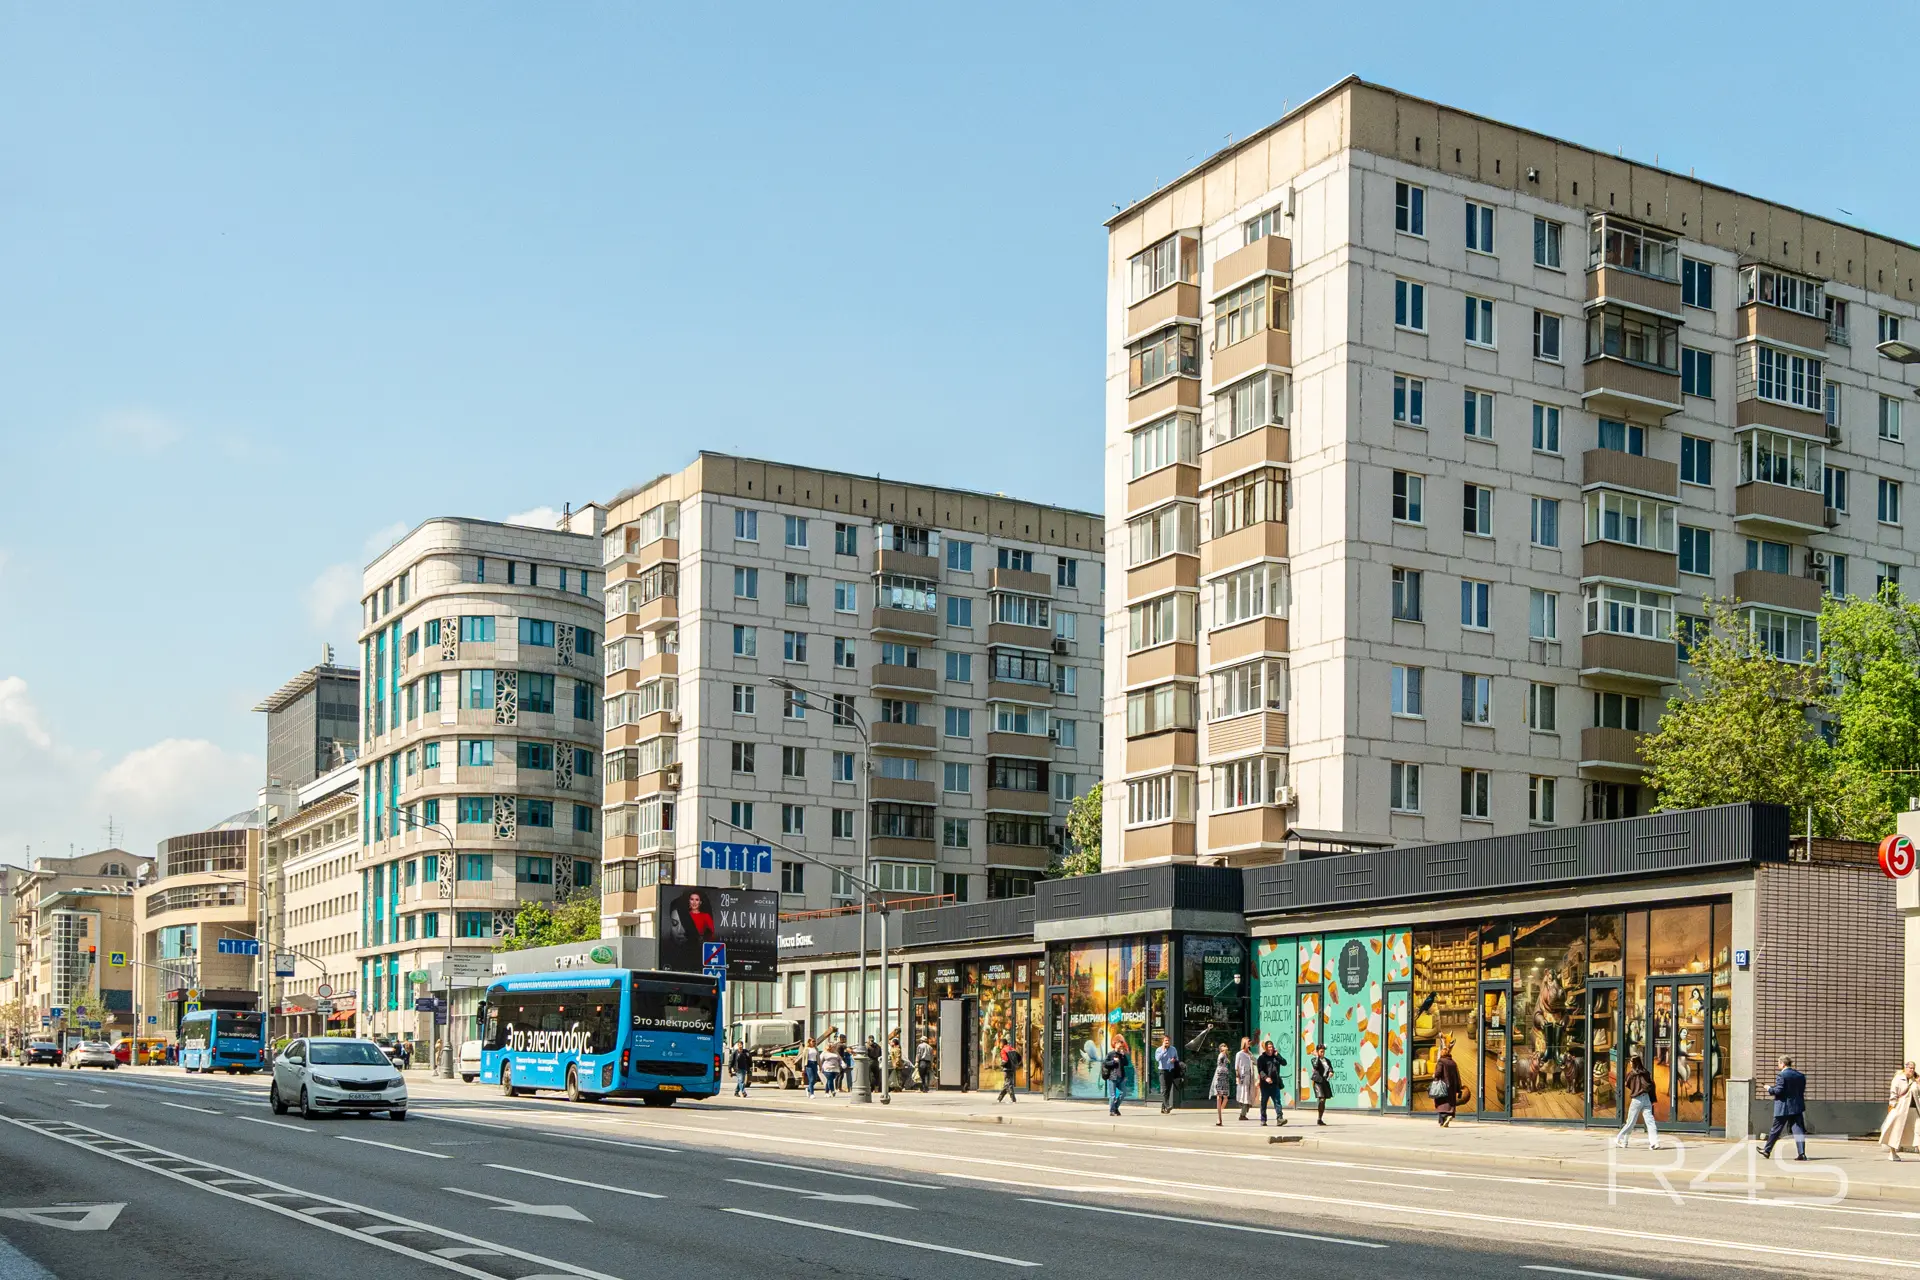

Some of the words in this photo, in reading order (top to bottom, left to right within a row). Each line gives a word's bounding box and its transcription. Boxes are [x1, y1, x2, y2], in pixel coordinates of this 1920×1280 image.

[1893, 839, 1909, 871] 5
[720, 893, 730, 907] 28
[720, 910, 775, 930] ЖАСМИН
[1735, 952, 1746, 963] 12
[1260, 958, 1290, 978] СКОРО
[633, 1015, 652, 1025] Это
[654, 1018, 714, 1031] электробус.
[1070, 1014, 1079, 1024] НЕ
[1121, 1011, 1146, 1022] ПРЕСНЯ
[1264, 1009, 1292, 1023] РАДОСТИ
[505, 1022, 525, 1052] Это
[526, 1021, 594, 1062] электробус.
[1330, 1032, 1357, 1043] ЗАВТРАКИ
[1329, 1045, 1358, 1056] СЭНДВИЧИ
